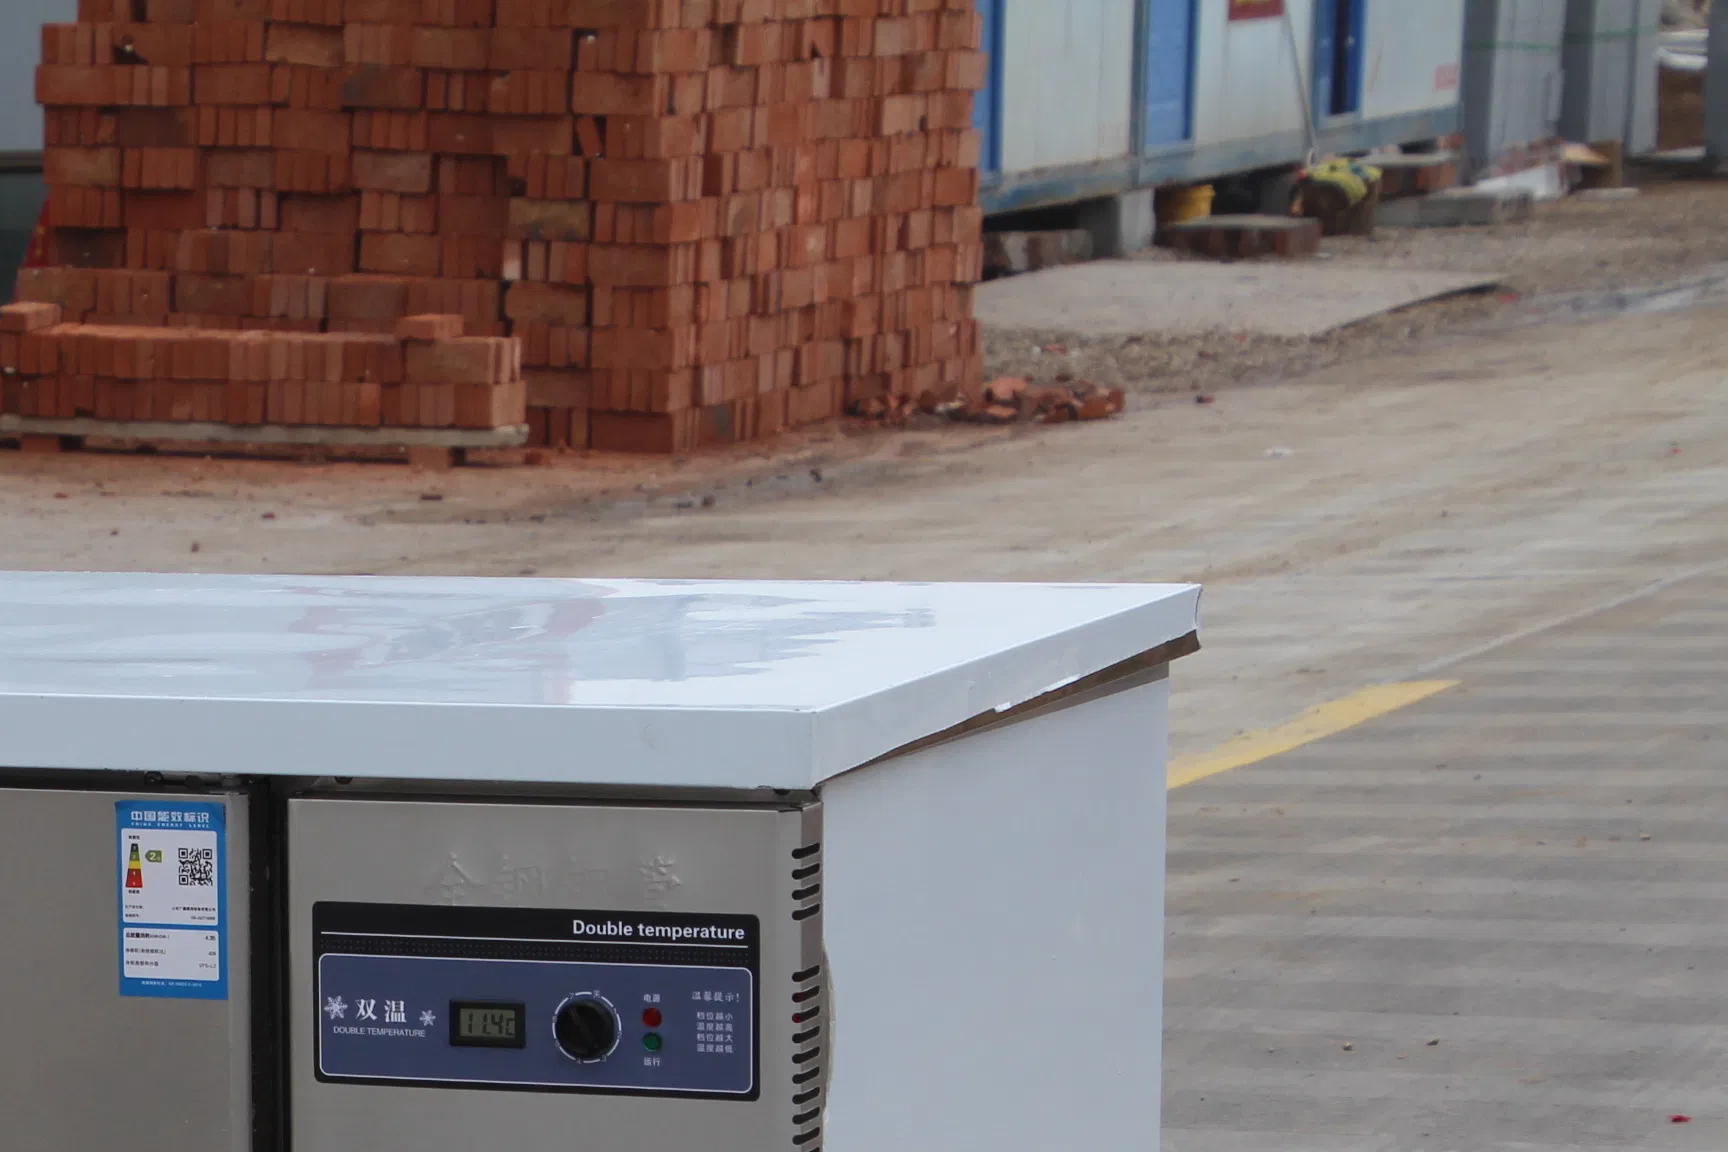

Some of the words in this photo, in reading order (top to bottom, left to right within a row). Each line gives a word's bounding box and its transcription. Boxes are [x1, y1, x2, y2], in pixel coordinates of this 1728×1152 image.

[131, 811, 210, 823] 中国能效标识
[572, 920, 633, 937] Double
[637, 923, 746, 941] temperature
[643, 994, 661, 1003] 电源
[355, 998, 407, 1023] 双温
[696, 1011, 734, 1022] 档位越小
[333, 1026, 366, 1035] DOUBLE
[367, 1027, 426, 1038] TEMPERATURE
[696, 1022, 734, 1032] 温度越高
[696, 1033, 734, 1043] 档位越大
